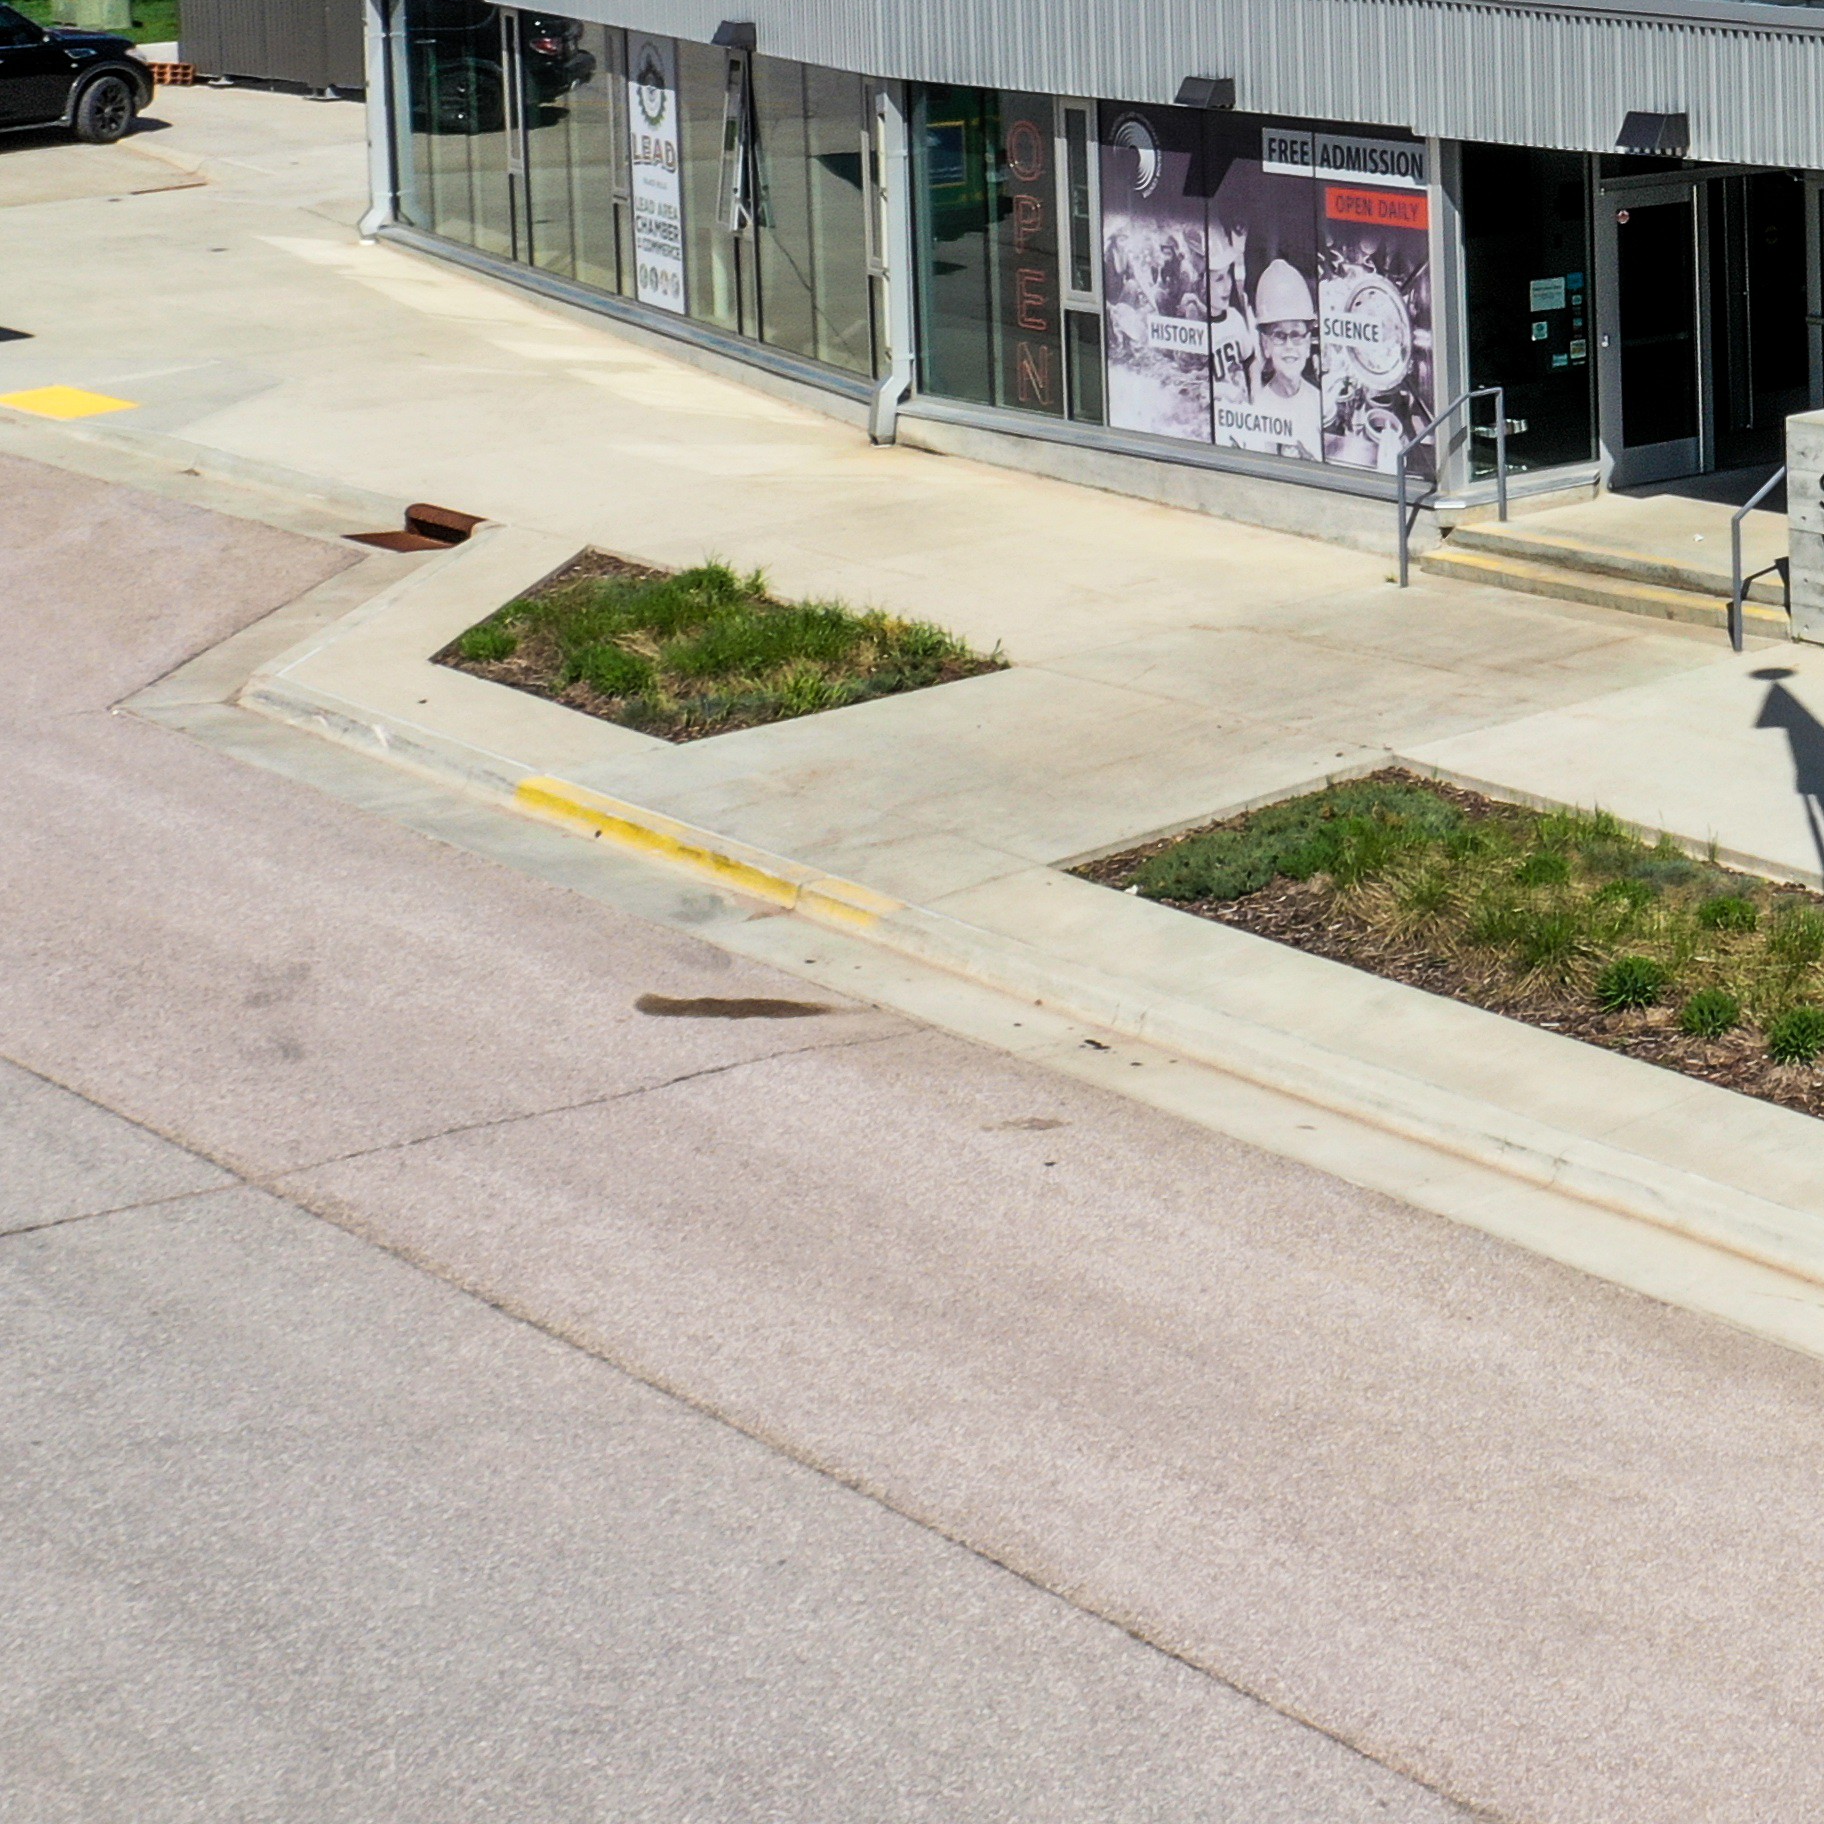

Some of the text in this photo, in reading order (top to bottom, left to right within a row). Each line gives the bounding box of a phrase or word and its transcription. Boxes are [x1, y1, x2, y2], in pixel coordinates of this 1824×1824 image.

[632, 132, 677, 174] LEAD
[1268, 137, 1424, 180] FREE ADMISSION
[1335, 195, 1420, 222] OPEN DAILY
[635, 215, 679, 242] CHAMBER
[1007, 120, 1054, 406] OPEN
[1151, 322, 1204, 346] HISTORY
[1323, 317, 1379, 343] SCIENCE
[1218, 408, 1293, 437] EDUCATION
